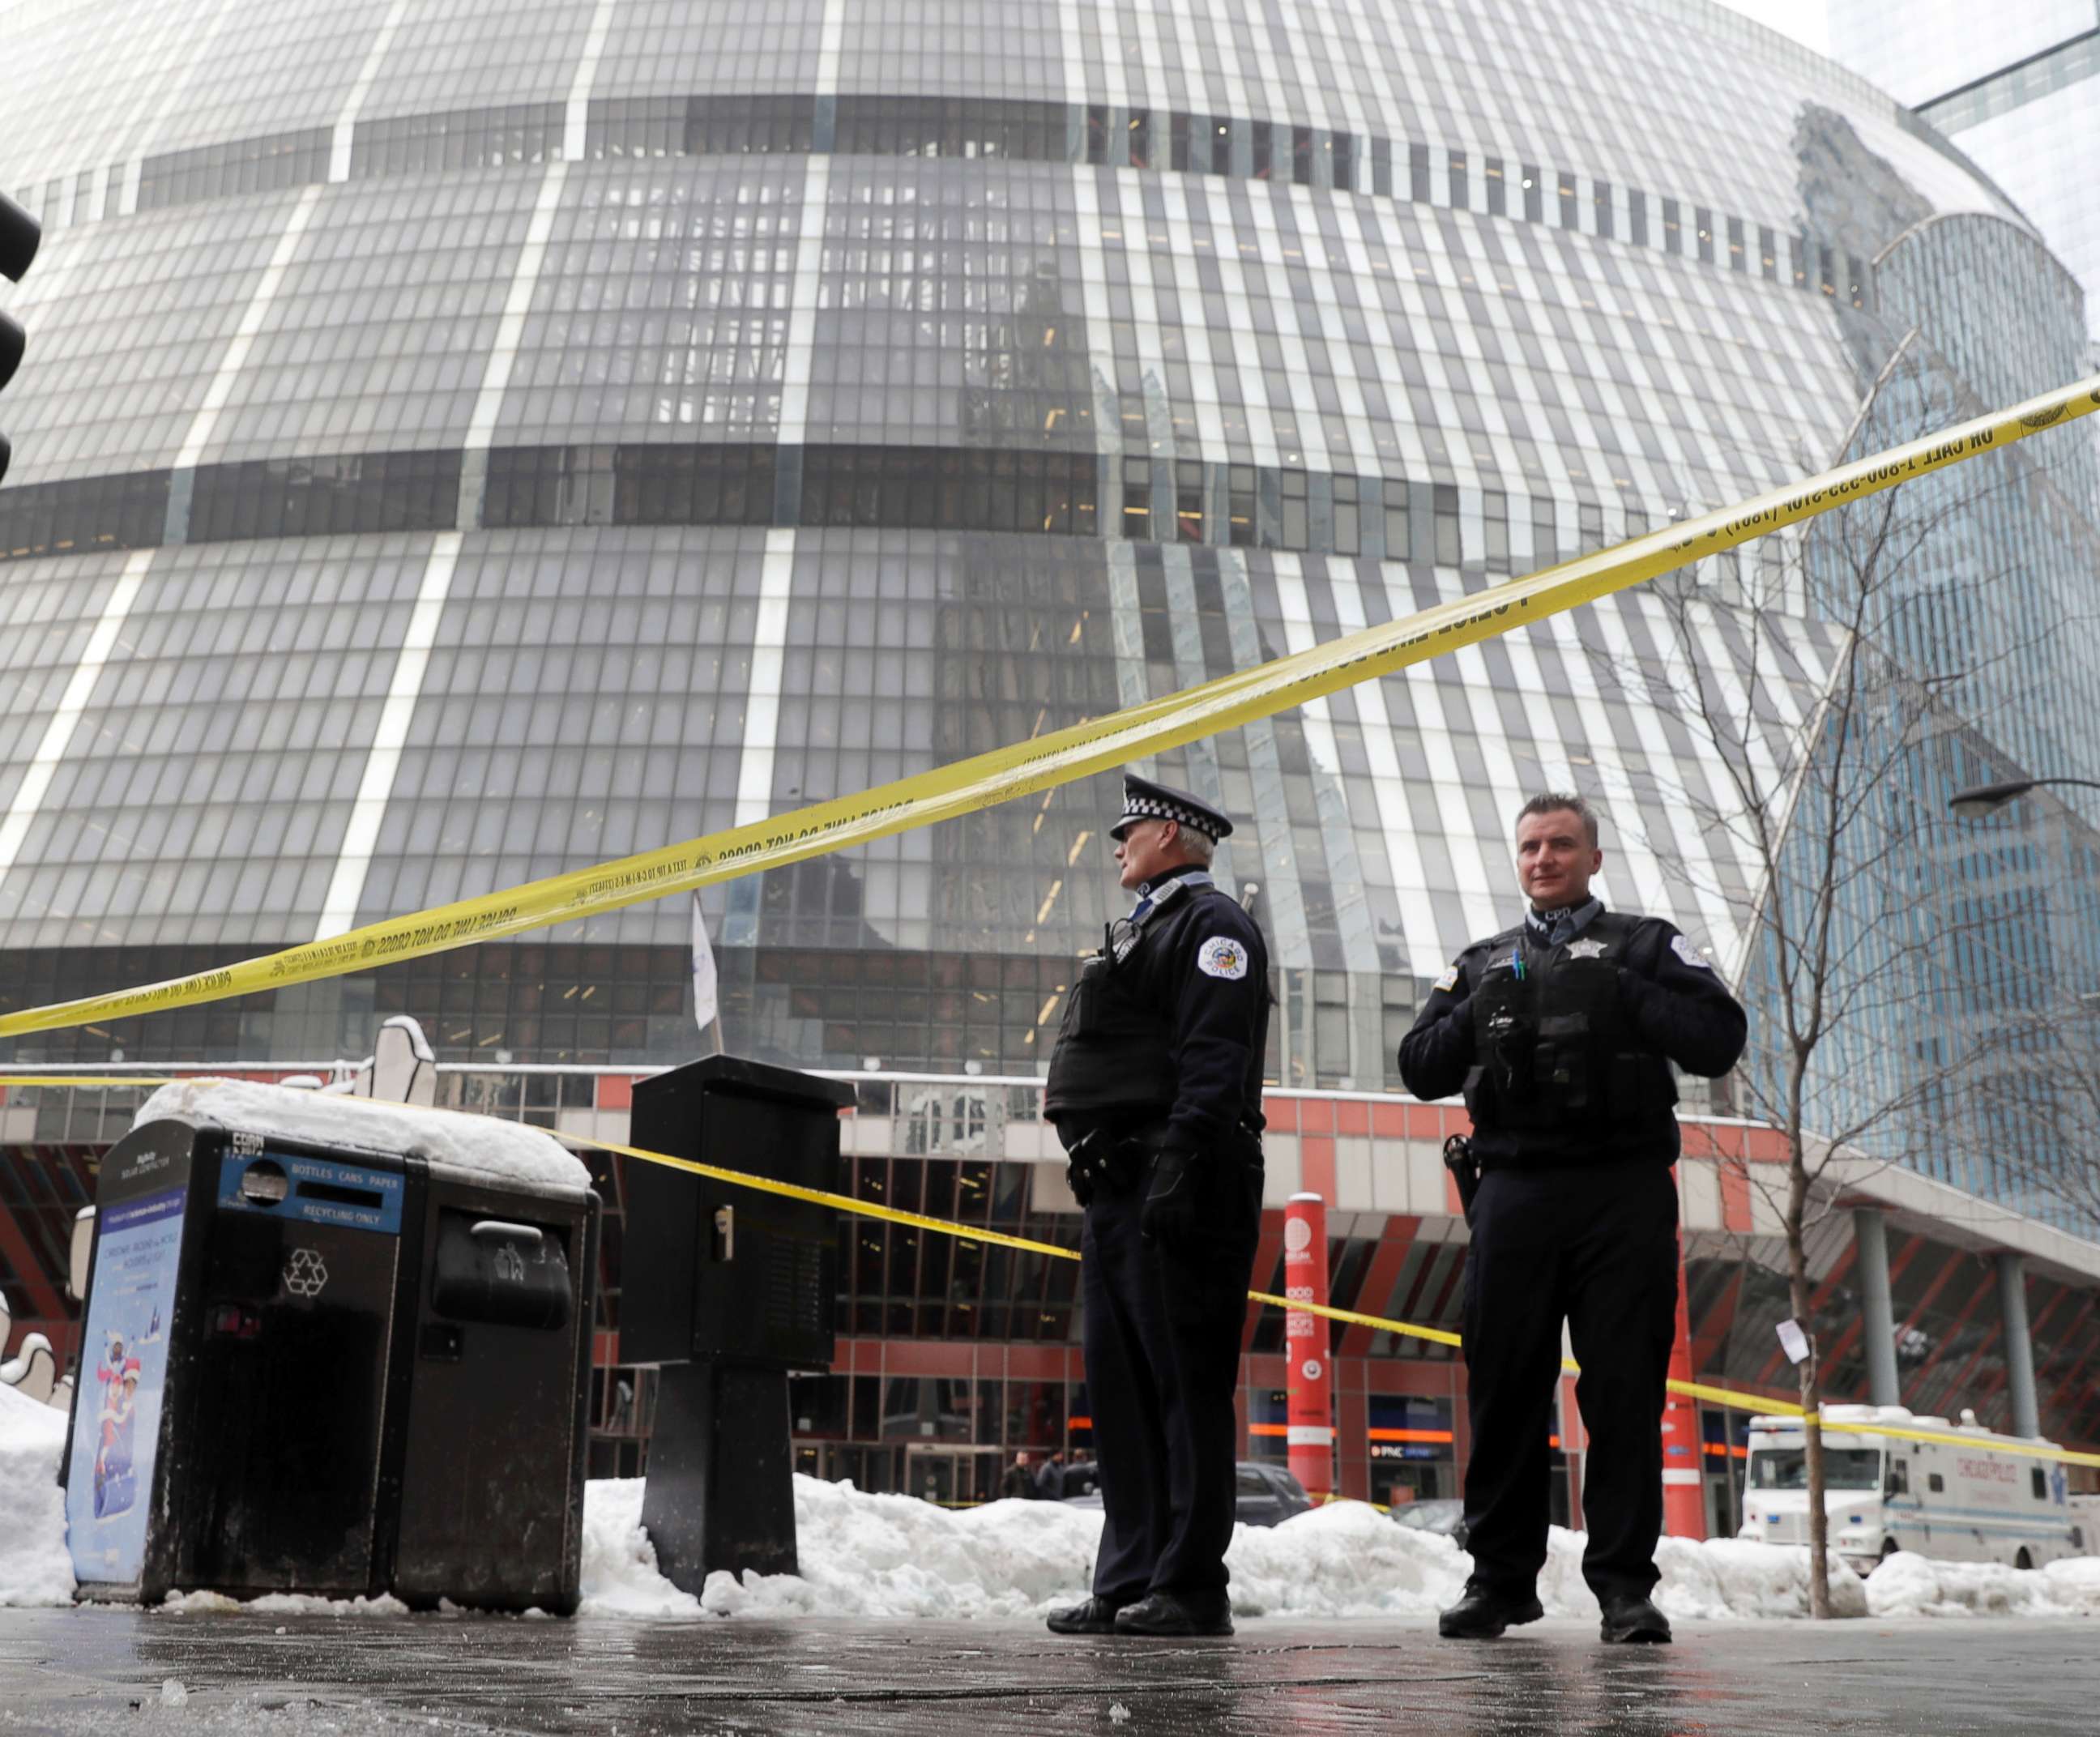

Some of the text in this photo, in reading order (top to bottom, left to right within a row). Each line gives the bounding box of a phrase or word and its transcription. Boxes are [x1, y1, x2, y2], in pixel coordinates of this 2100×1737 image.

[1206, 959, 1240, 976] POLICE
[292, 1163, 398, 1189] BOTTLES CANS PAPER
[304, 1204, 381, 1226] RECYCLING ONLY
